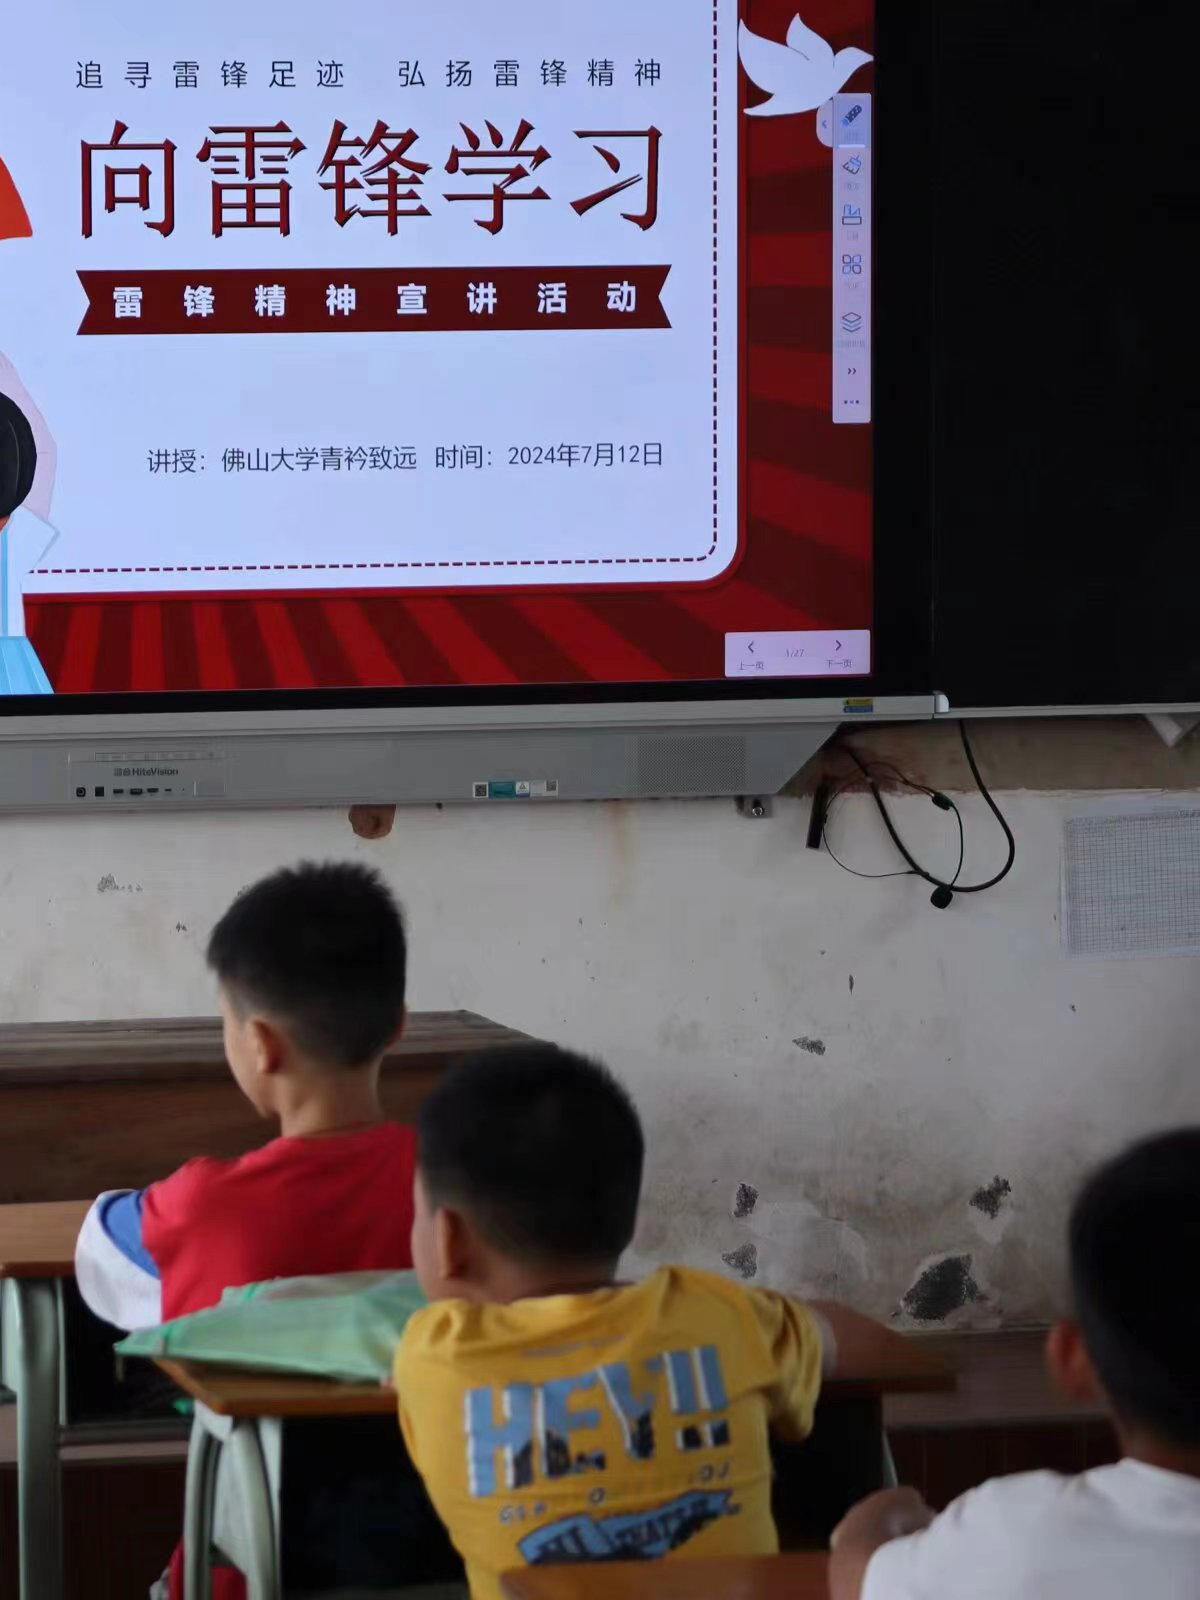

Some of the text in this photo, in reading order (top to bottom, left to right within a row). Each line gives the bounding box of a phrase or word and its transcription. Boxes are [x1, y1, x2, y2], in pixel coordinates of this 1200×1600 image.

[75, 58, 662, 89] 追寻雷锋足迹 弘扬雷锋精神
[80, 118, 664, 240] 向雷锋学习
[112, 279, 637, 319] 雷锋精神宣讲活动
[132, 767, 179, 777] HiteVision
